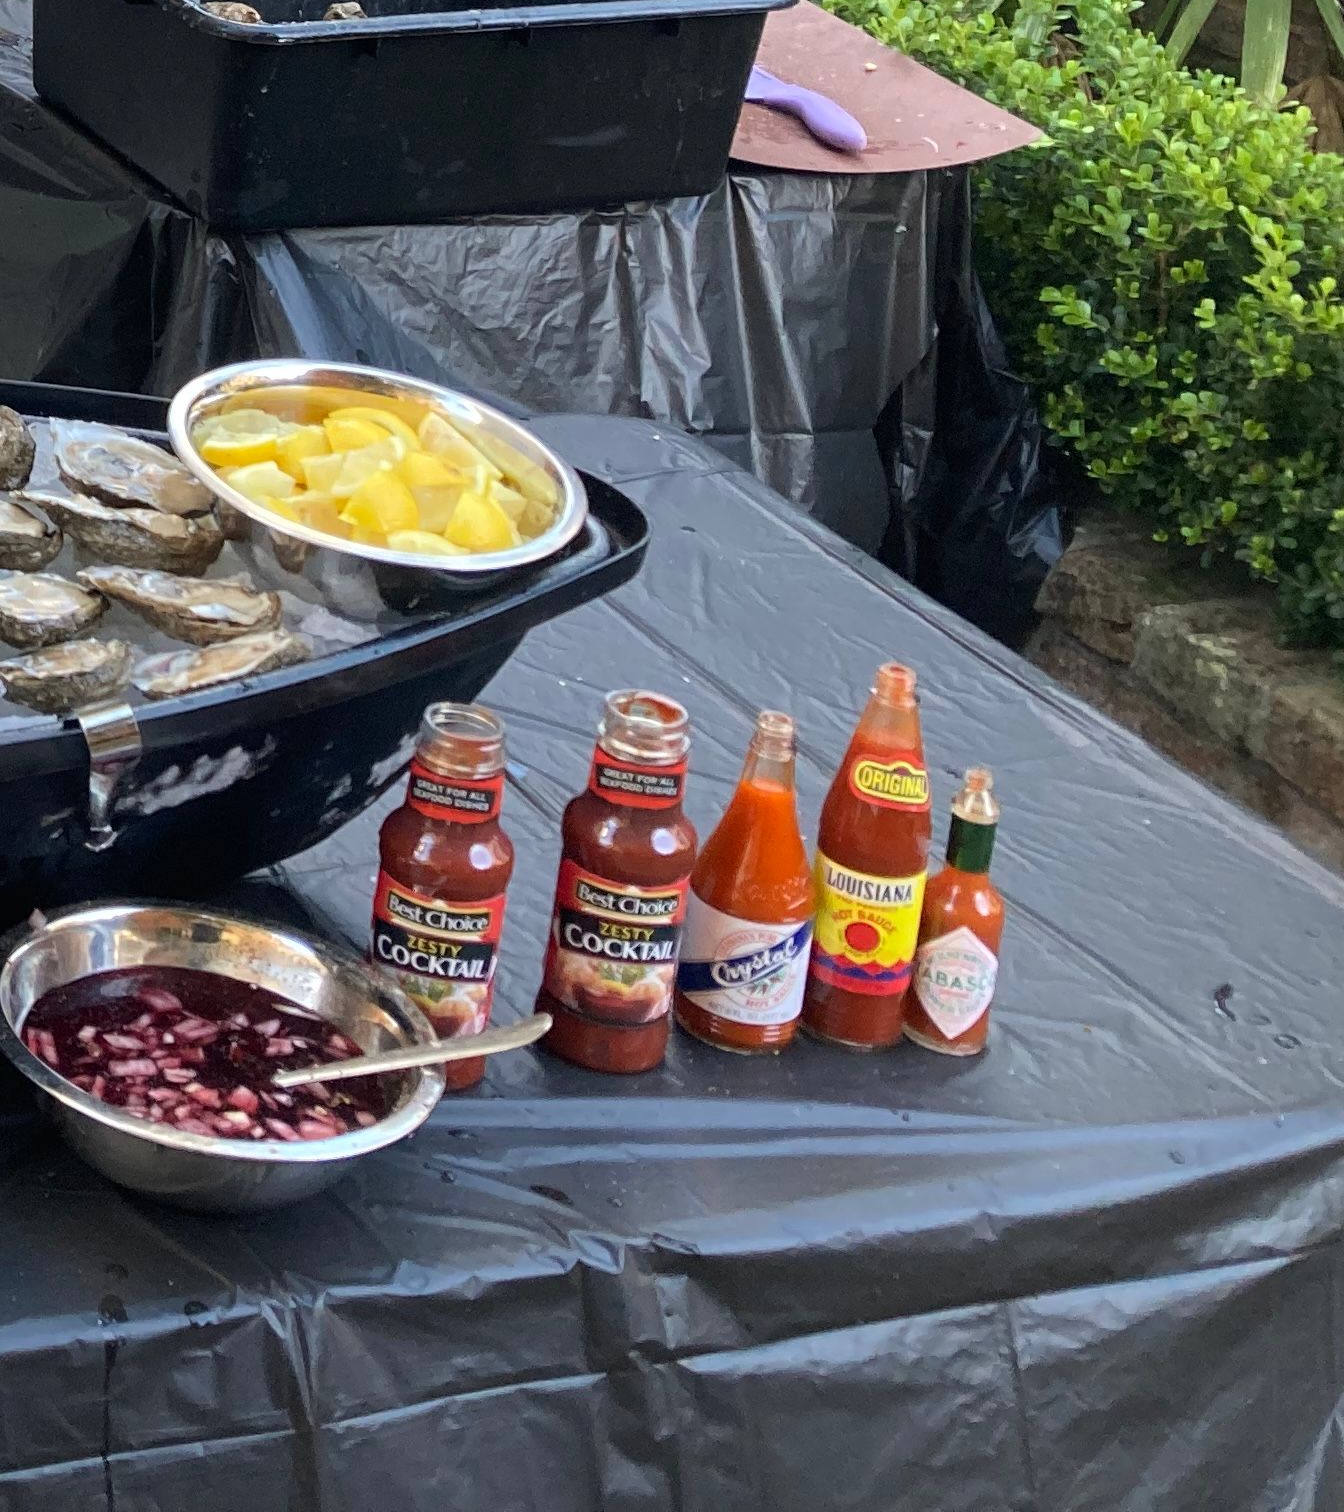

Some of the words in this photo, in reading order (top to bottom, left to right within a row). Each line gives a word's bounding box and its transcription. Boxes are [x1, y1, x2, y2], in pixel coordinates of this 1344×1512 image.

[861, 766, 926, 798] ORIGINAL
[578, 883, 617, 911] Best
[618, 897, 678, 916] Choice
[826, 866, 913, 903] LOUISIANA
[388, 894, 424, 924] Best
[425, 910, 488, 932] Choice
[407, 935, 463, 958] ZESTY
[565, 923, 674, 961] COCKTAIL
[599, 922, 655, 942] ZESTY
[377, 934, 486, 979] COCKTAIL
[711, 936, 798, 989] Crystal
[921, 966, 993, 992] ABASC
